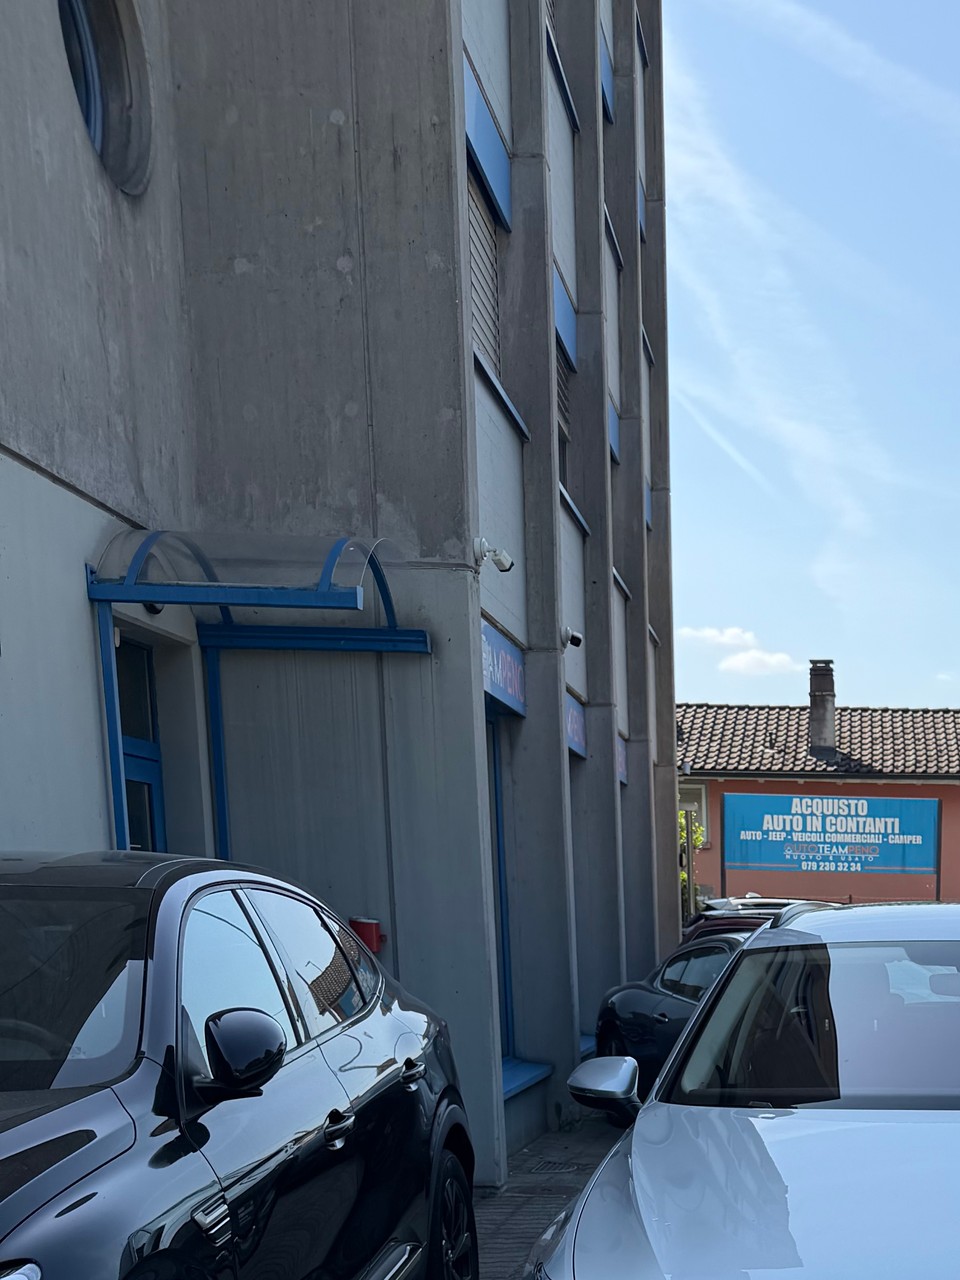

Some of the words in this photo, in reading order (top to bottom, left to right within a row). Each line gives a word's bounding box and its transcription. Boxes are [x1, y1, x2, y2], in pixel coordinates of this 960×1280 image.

[791, 798, 868, 816] ACQUISTO
[763, 815, 802, 831] AUTO
[806, 816, 822, 831] IN
[825, 816, 899, 833] CONTANTI
[740, 831, 762, 840] AUTO
[768, 832, 786, 841] JEEP
[793, 832, 824, 842] VEICOLI
[825, 833, 882, 843] COMMERCIALI
[888, 835, 922, 844] CAMPER
[802, 862, 817, 870] 079
[819, 862, 836, 871] 230
[838, 862, 849, 871] 32
[850, 863, 861, 871] 34
